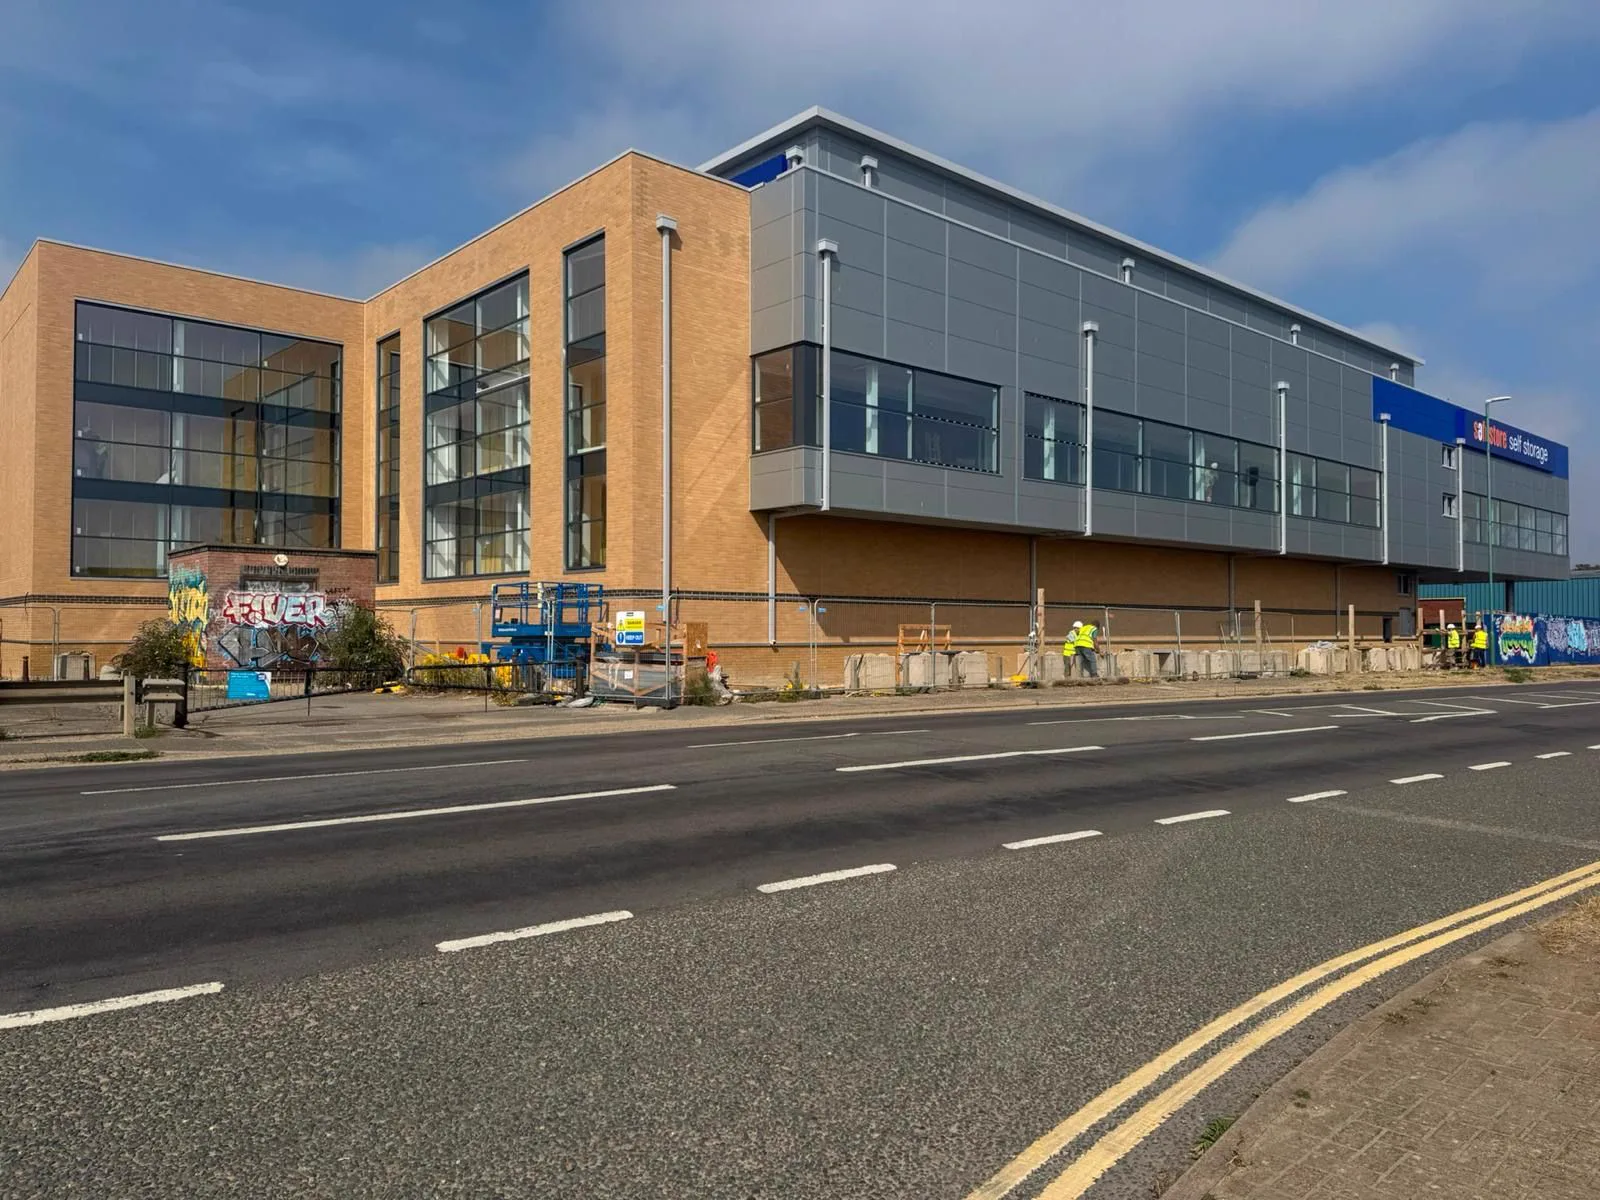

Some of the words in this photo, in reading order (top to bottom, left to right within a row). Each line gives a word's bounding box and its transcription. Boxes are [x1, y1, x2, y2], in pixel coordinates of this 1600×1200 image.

[1473, 420, 1507, 449] safstore
[1509, 435, 1522, 453] self
[1523, 439, 1548, 464] storage
